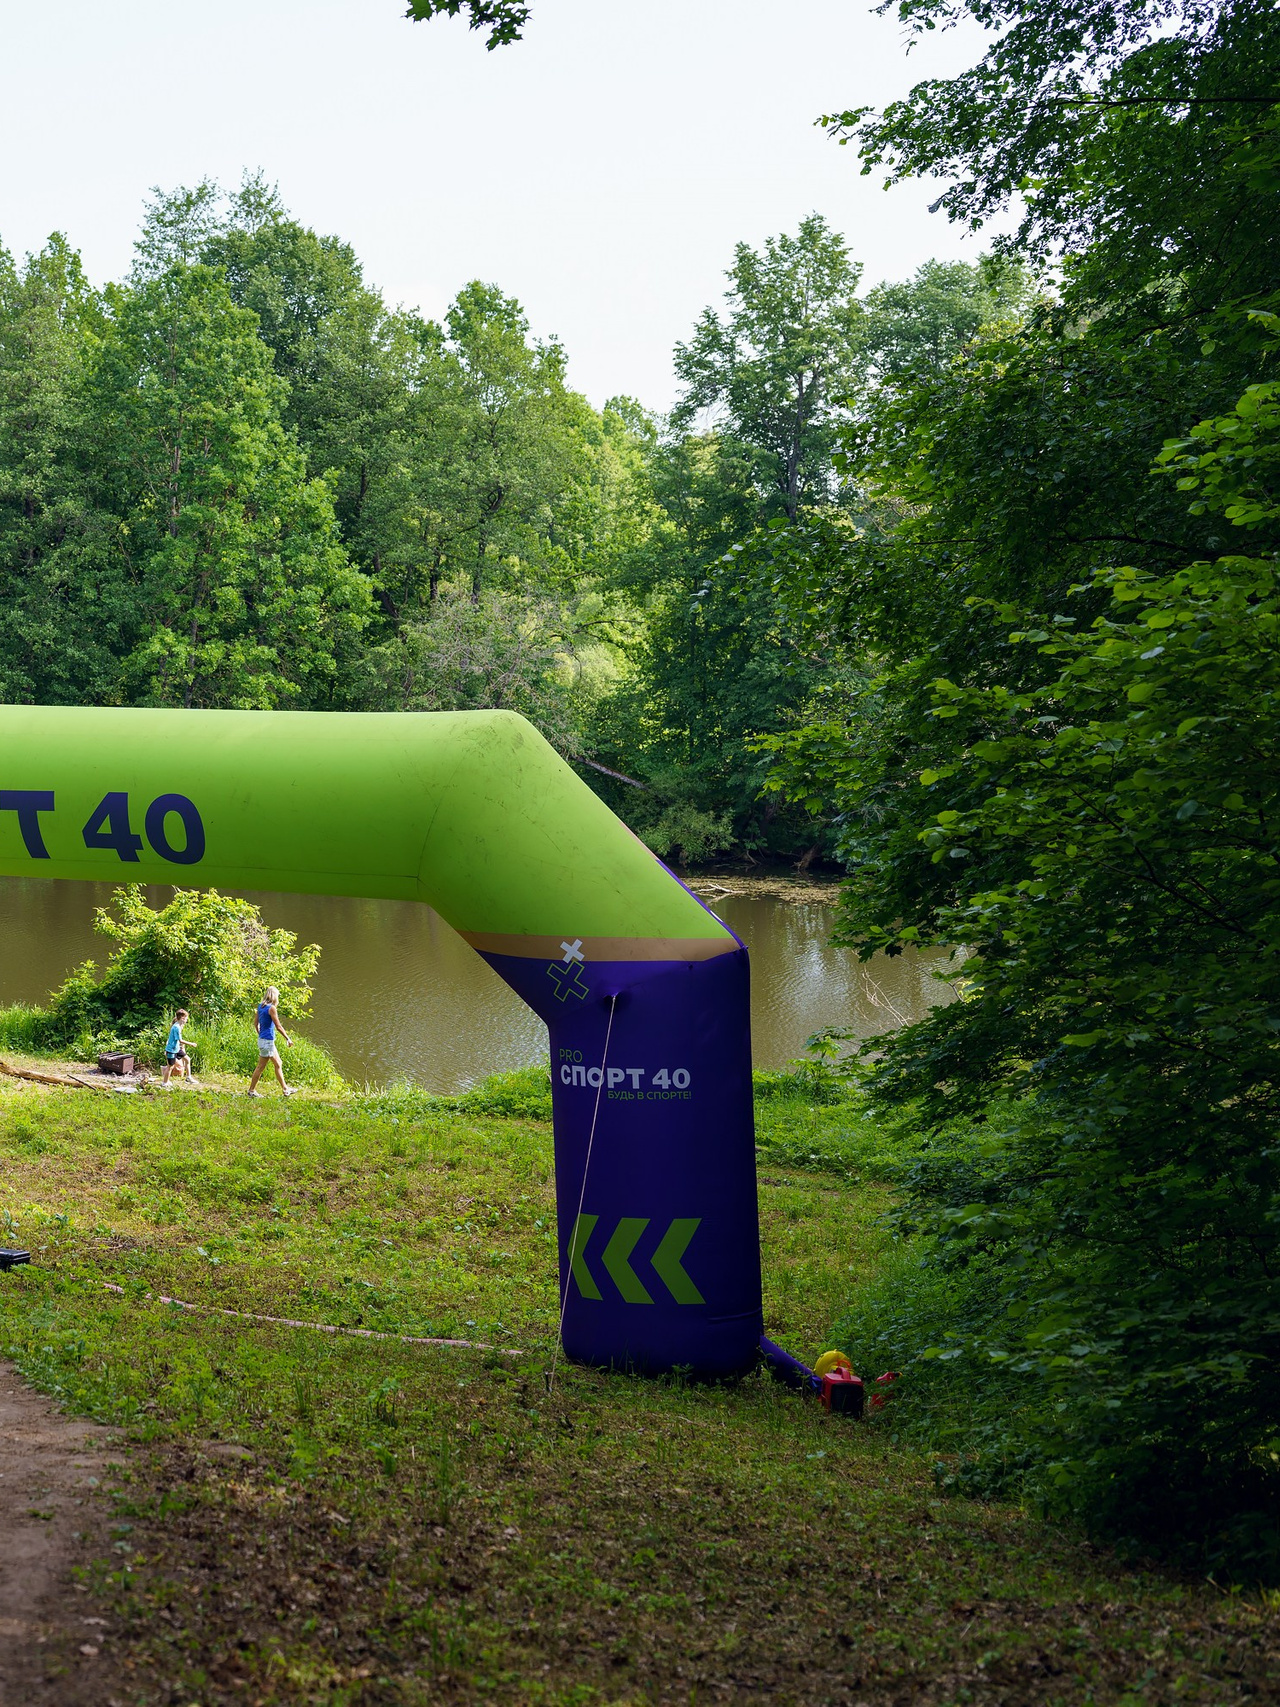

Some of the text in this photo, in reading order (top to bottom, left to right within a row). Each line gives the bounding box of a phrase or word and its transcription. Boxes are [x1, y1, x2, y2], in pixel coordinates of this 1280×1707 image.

[81, 791, 206, 865] 40
[559, 1048, 583, 1063] PRO
[560, 1064, 691, 1090] СПОРТ 40
[607, 1090, 692, 1101] БУДЬ В СПОРТЕ!
